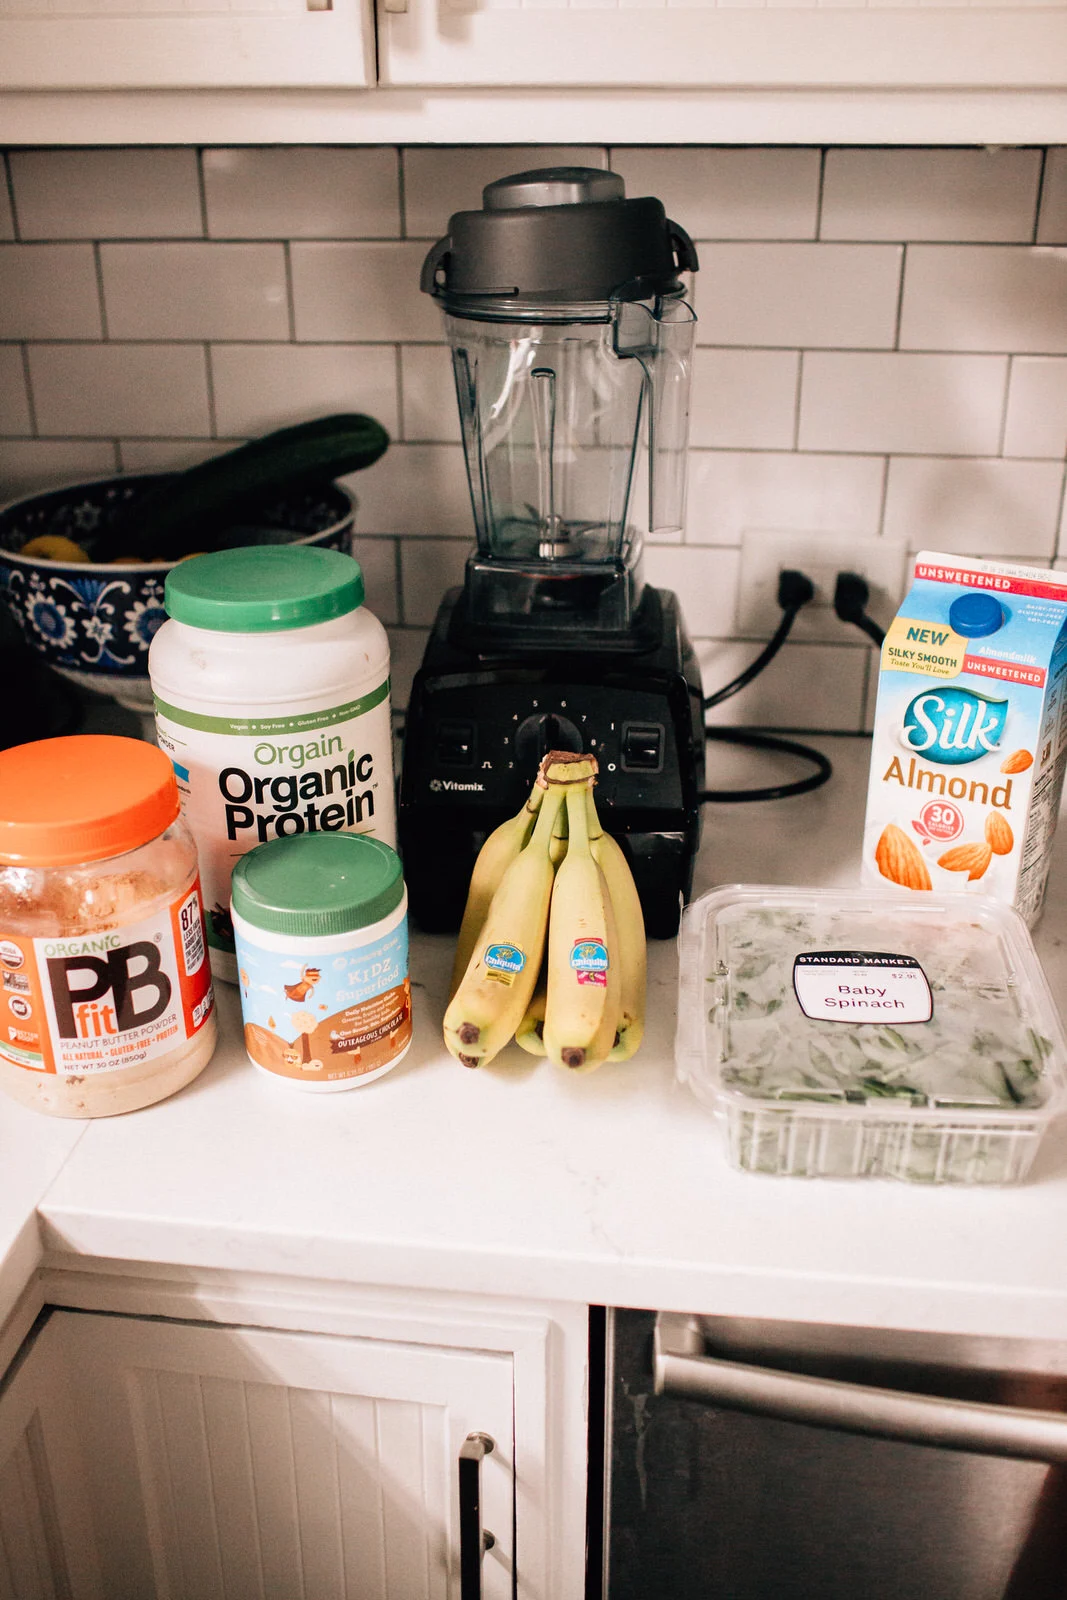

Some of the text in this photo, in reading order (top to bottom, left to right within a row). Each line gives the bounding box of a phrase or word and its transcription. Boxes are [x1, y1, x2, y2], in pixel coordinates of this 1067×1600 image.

[918, 566, 1011, 590] UNSWEETENED
[906, 626, 950, 647] NEW
[888, 646, 958, 668] SILKY SMOOTH
[978, 645, 1038, 665] Almondmilk
[890, 657, 950, 676] Taste You'll Love
[967, 661, 1042, 684] UNSWEETENED
[561, 700, 567, 708] 6
[230, 723, 249, 731] Vegan
[260, 723, 272, 731] Soy
[297, 719, 317, 727] Gluten
[901, 694, 1002, 752] Silk
[503, 737, 509, 745] 3
[253, 734, 344, 770] Orgain
[508, 761, 514, 769] 2
[218, 749, 374, 813] Organic
[443, 781, 484, 792] Vitamix
[882, 755, 1013, 811] Almond
[225, 788, 375, 843] Protein
[930, 805, 955, 825] 30
[485, 955, 521, 972] Chiquita
[799, 956, 913, 966] STANDARD MARKET
[347, 957, 392, 987] KIDZ
[46, 940, 172, 1040] PB
[838, 985, 887, 998] Baby
[824, 997, 905, 1010] Spinach
[76, 1003, 118, 1039] fit
[337, 1030, 378, 1049] OUTRAGEOUS
[378, 1011, 404, 1036] CHOCOLATE
[60, 1013, 178, 1051] PEANUT BUTTER POWDER
[62, 1024, 179, 1061] ALL NATURAL GLUTEN-FREE PROTEIN
[96, 1061, 107, 1069] 30
[108, 1059, 120, 1067] OZ
